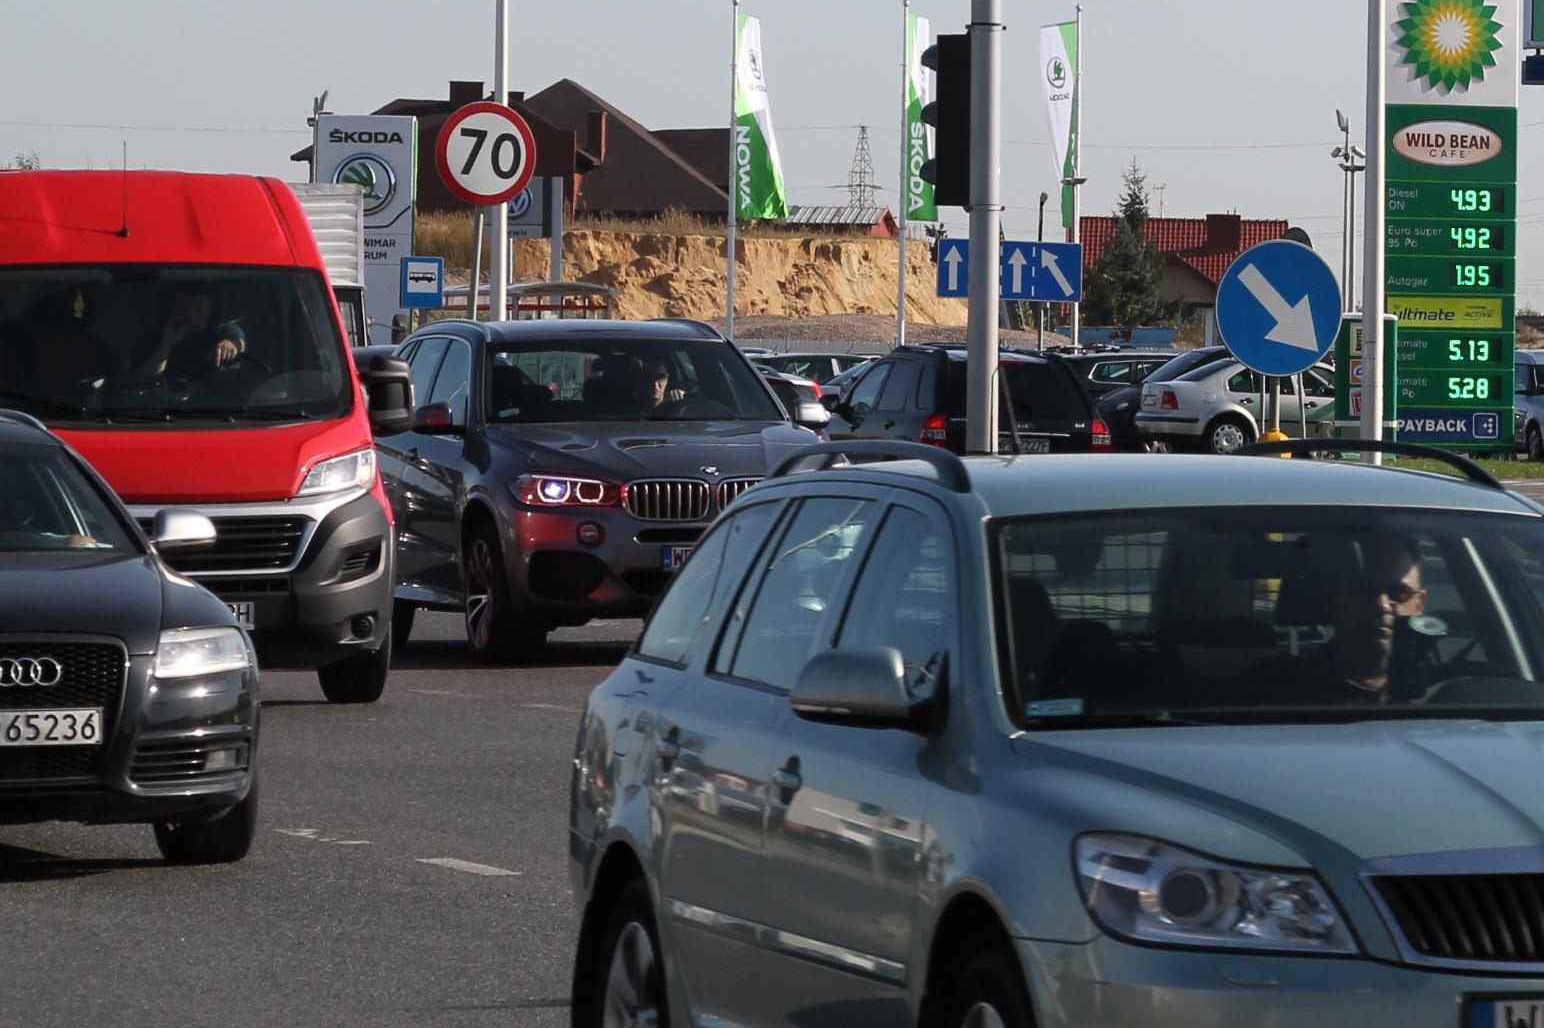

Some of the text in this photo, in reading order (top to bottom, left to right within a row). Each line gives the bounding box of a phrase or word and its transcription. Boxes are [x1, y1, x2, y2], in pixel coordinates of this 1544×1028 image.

[329, 128, 403, 144] ŠKODA
[1406, 133, 1490, 150] WILD BEAN
[459, 128, 521, 180] 70
[1429, 149, 1466, 159] CAFE
[736, 125, 751, 210] NOWA
[908, 122, 925, 213] ŠKODA
[1388, 188, 1418, 198] Diesel
[1388, 200, 1405, 210] ON
[1388, 225, 1443, 237] Euro super
[1388, 238, 1418, 248] 95 Pb
[364, 251, 387, 260] RUM
[1388, 276, 1428, 287] Autogaz
[1398, 339, 1428, 348] imate
[1449, 339, 1489, 361] 5.13
[1398, 377, 1428, 386] imate
[1397, 420, 1466, 433] PAYBACK
[6, 713, 95, 742] 65236
